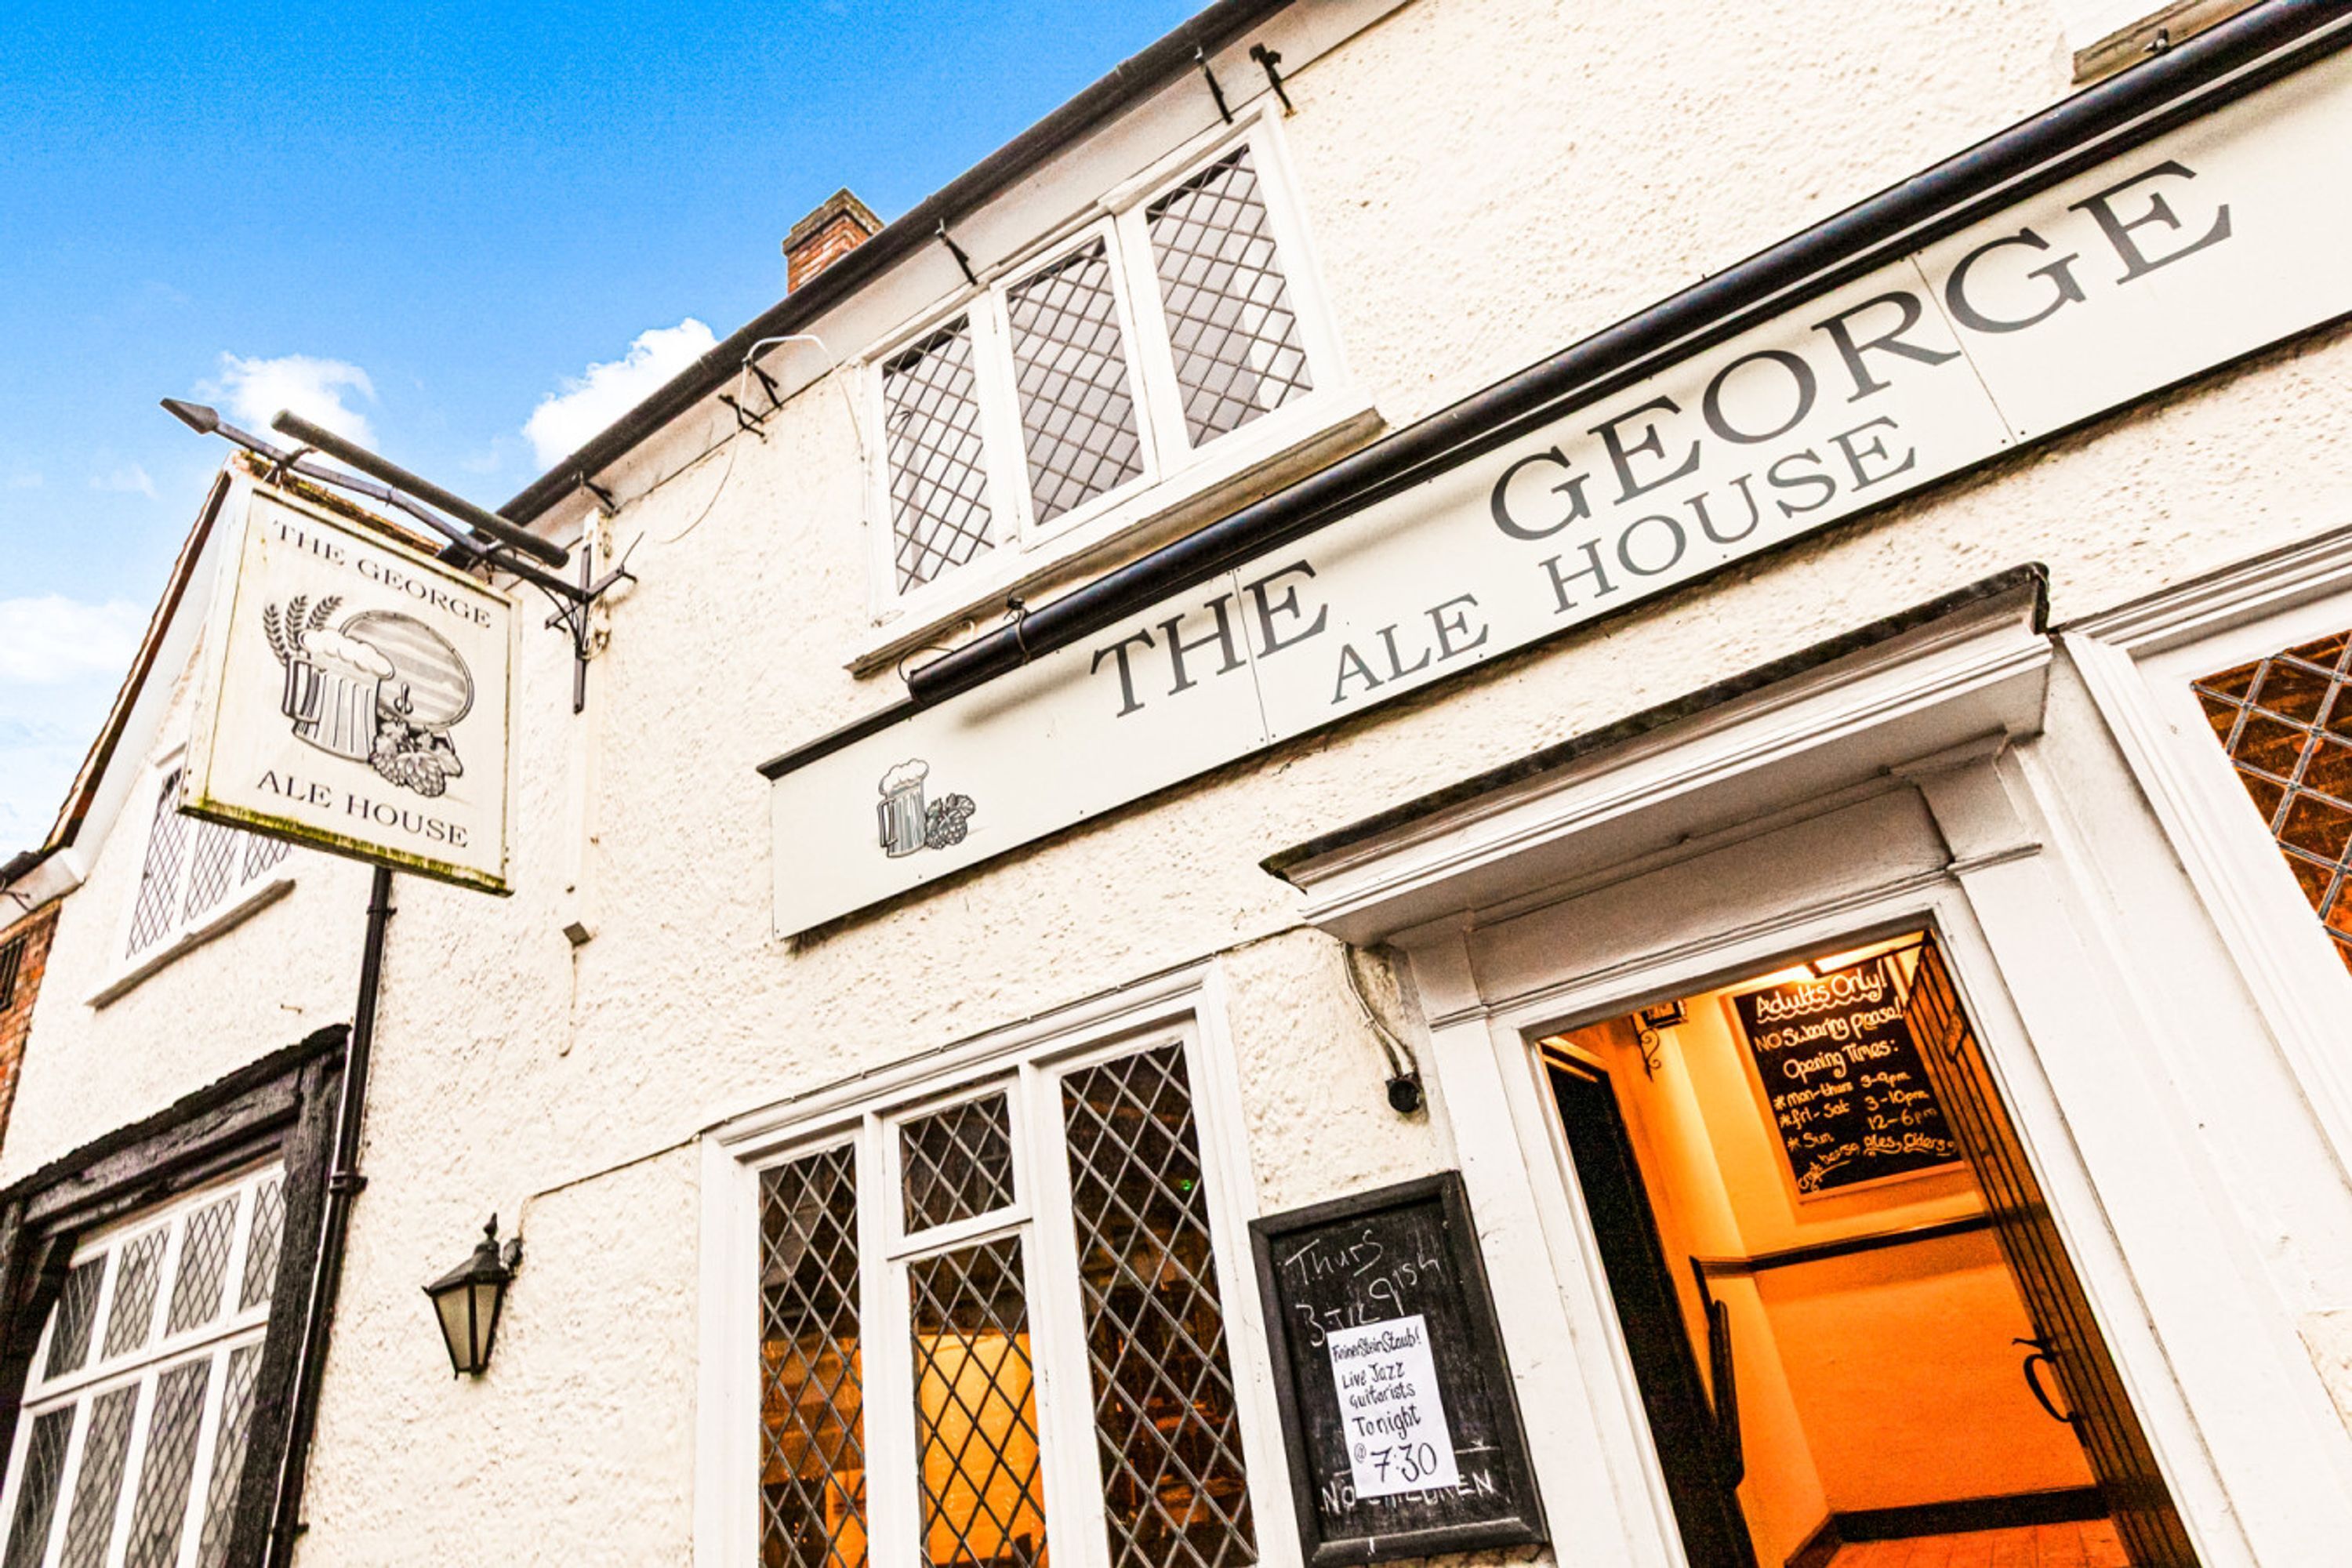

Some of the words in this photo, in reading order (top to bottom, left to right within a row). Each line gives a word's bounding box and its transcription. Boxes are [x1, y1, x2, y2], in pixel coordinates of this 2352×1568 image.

[1091, 559, 1328, 718] THE
[1490, 161, 2232, 541] GEORGE
[274, 519, 345, 566] THE
[358, 559, 492, 629] GEORGE
[1330, 593, 1490, 705] ALE
[1538, 416, 1915, 615] HOUSE
[257, 769, 332, 809] ALE
[346, 793, 469, 848] HOUSE
[1756, 983, 1831, 1018] Adults
[1831, 958, 1888, 1003] Only!
[1782, 1018, 1850, 1047] Swearing
[1783, 1051, 1846, 1083] Opening
[1368, 1362, 1405, 1382] Jazz
[1352, 1404, 1421, 1440] Tonight
[1370, 1442, 1437, 1483] 7:30
